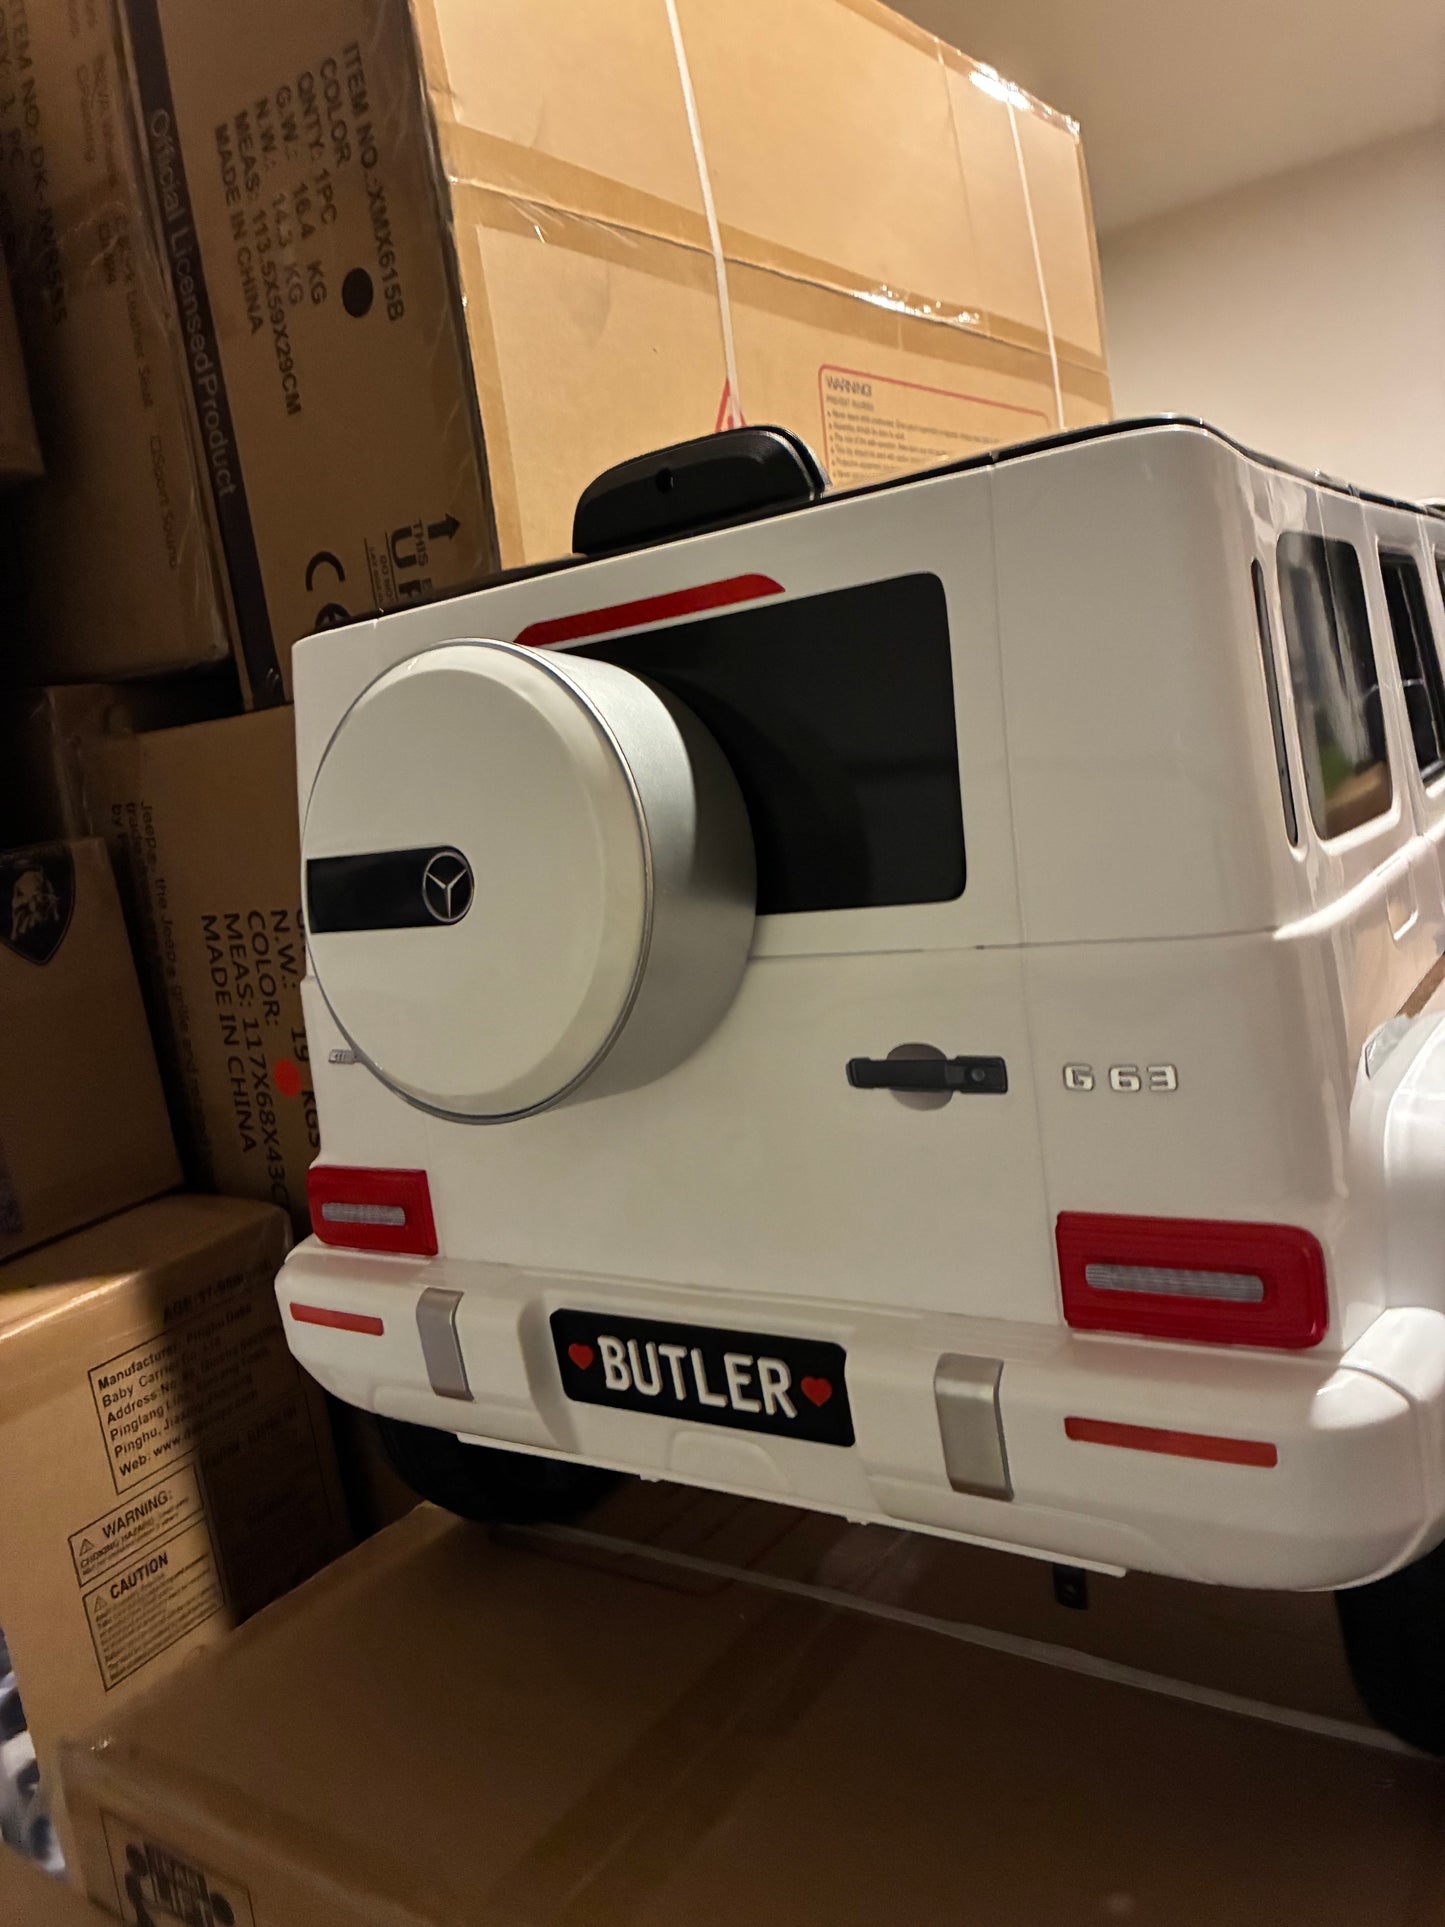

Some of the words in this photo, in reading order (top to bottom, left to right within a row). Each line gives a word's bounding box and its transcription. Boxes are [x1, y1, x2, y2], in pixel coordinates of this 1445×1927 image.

[320, 57, 351, 168] COLOR
[343, 42, 370, 118] ITEM
[148, 109, 185, 224] Official
[215, 122, 242, 207] MADE
[235, 109, 260, 202] MEAS:
[229, 210, 247, 242] IN
[315, 168, 338, 224] 1PC
[237, 245, 264, 336] CHINA
[283, 262, 304, 307] KG
[307, 260, 328, 306] KG
[412, 518, 429, 566] THIS
[201, 914, 233, 1005] MADE
[223, 912, 254, 1008] MEAS:
[247, 909, 280, 1025] COLOR:
[271, 909, 298, 989] N.W.:
[291, 1026, 309, 1062] 19
[219, 1013, 238, 1046] IN
[227, 1057, 258, 1154] CHINA
[1062, 1062, 1096, 1092] G
[1108, 1063, 1179, 1093] 63
[102, 1384, 134, 1409] Baby
[139, 1355, 180, 1387] Carrier
[596, 1334, 799, 1419] BUTLER
[110, 1404, 165, 1442] Pinglang
[102, 1490, 173, 1538] WARNING:
[110, 1551, 168, 1599] CAUTION
